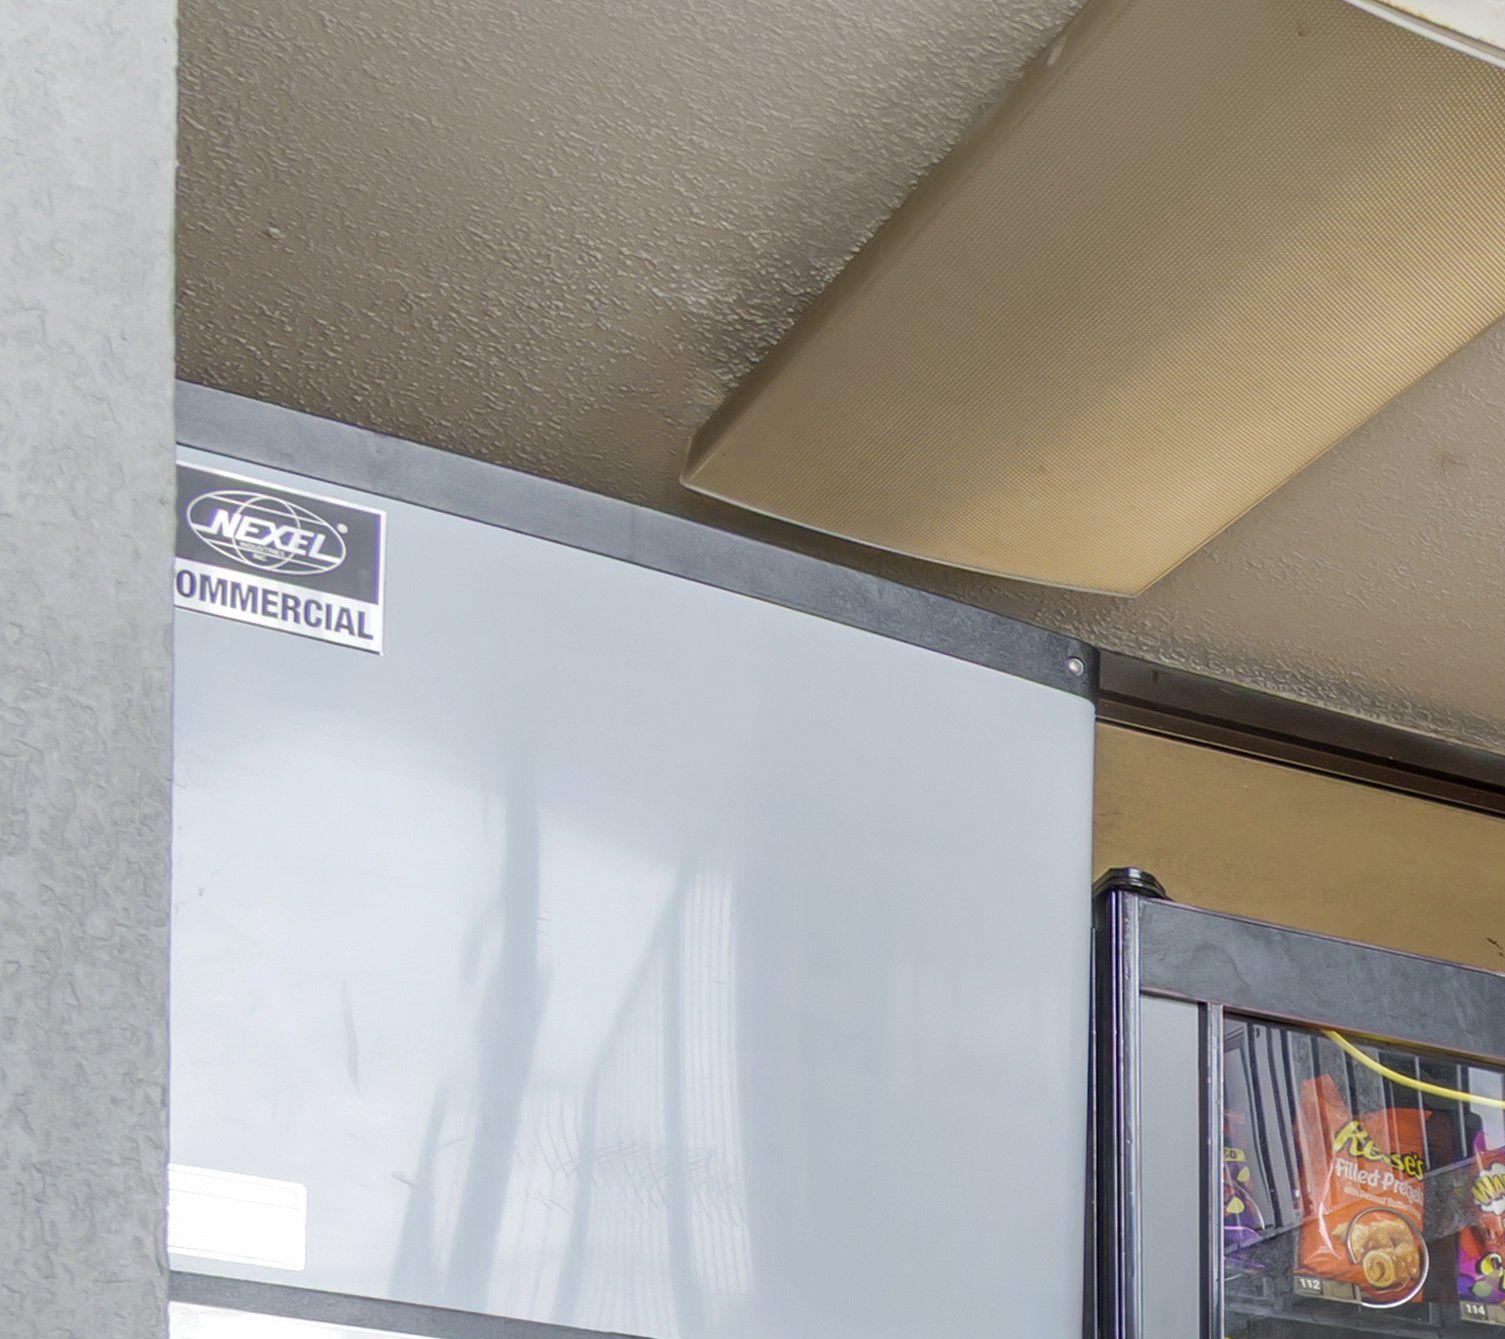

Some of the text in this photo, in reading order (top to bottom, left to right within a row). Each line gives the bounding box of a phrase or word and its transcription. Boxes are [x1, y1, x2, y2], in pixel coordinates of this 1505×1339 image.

[206, 508, 340, 562] NEXEL
[176, 569, 374, 641] OMMERCIAL
[1335, 1158, 1379, 1187] Filled
[1300, 1276, 1321, 1290] 112
[1466, 1304, 1485, 1316] 114
